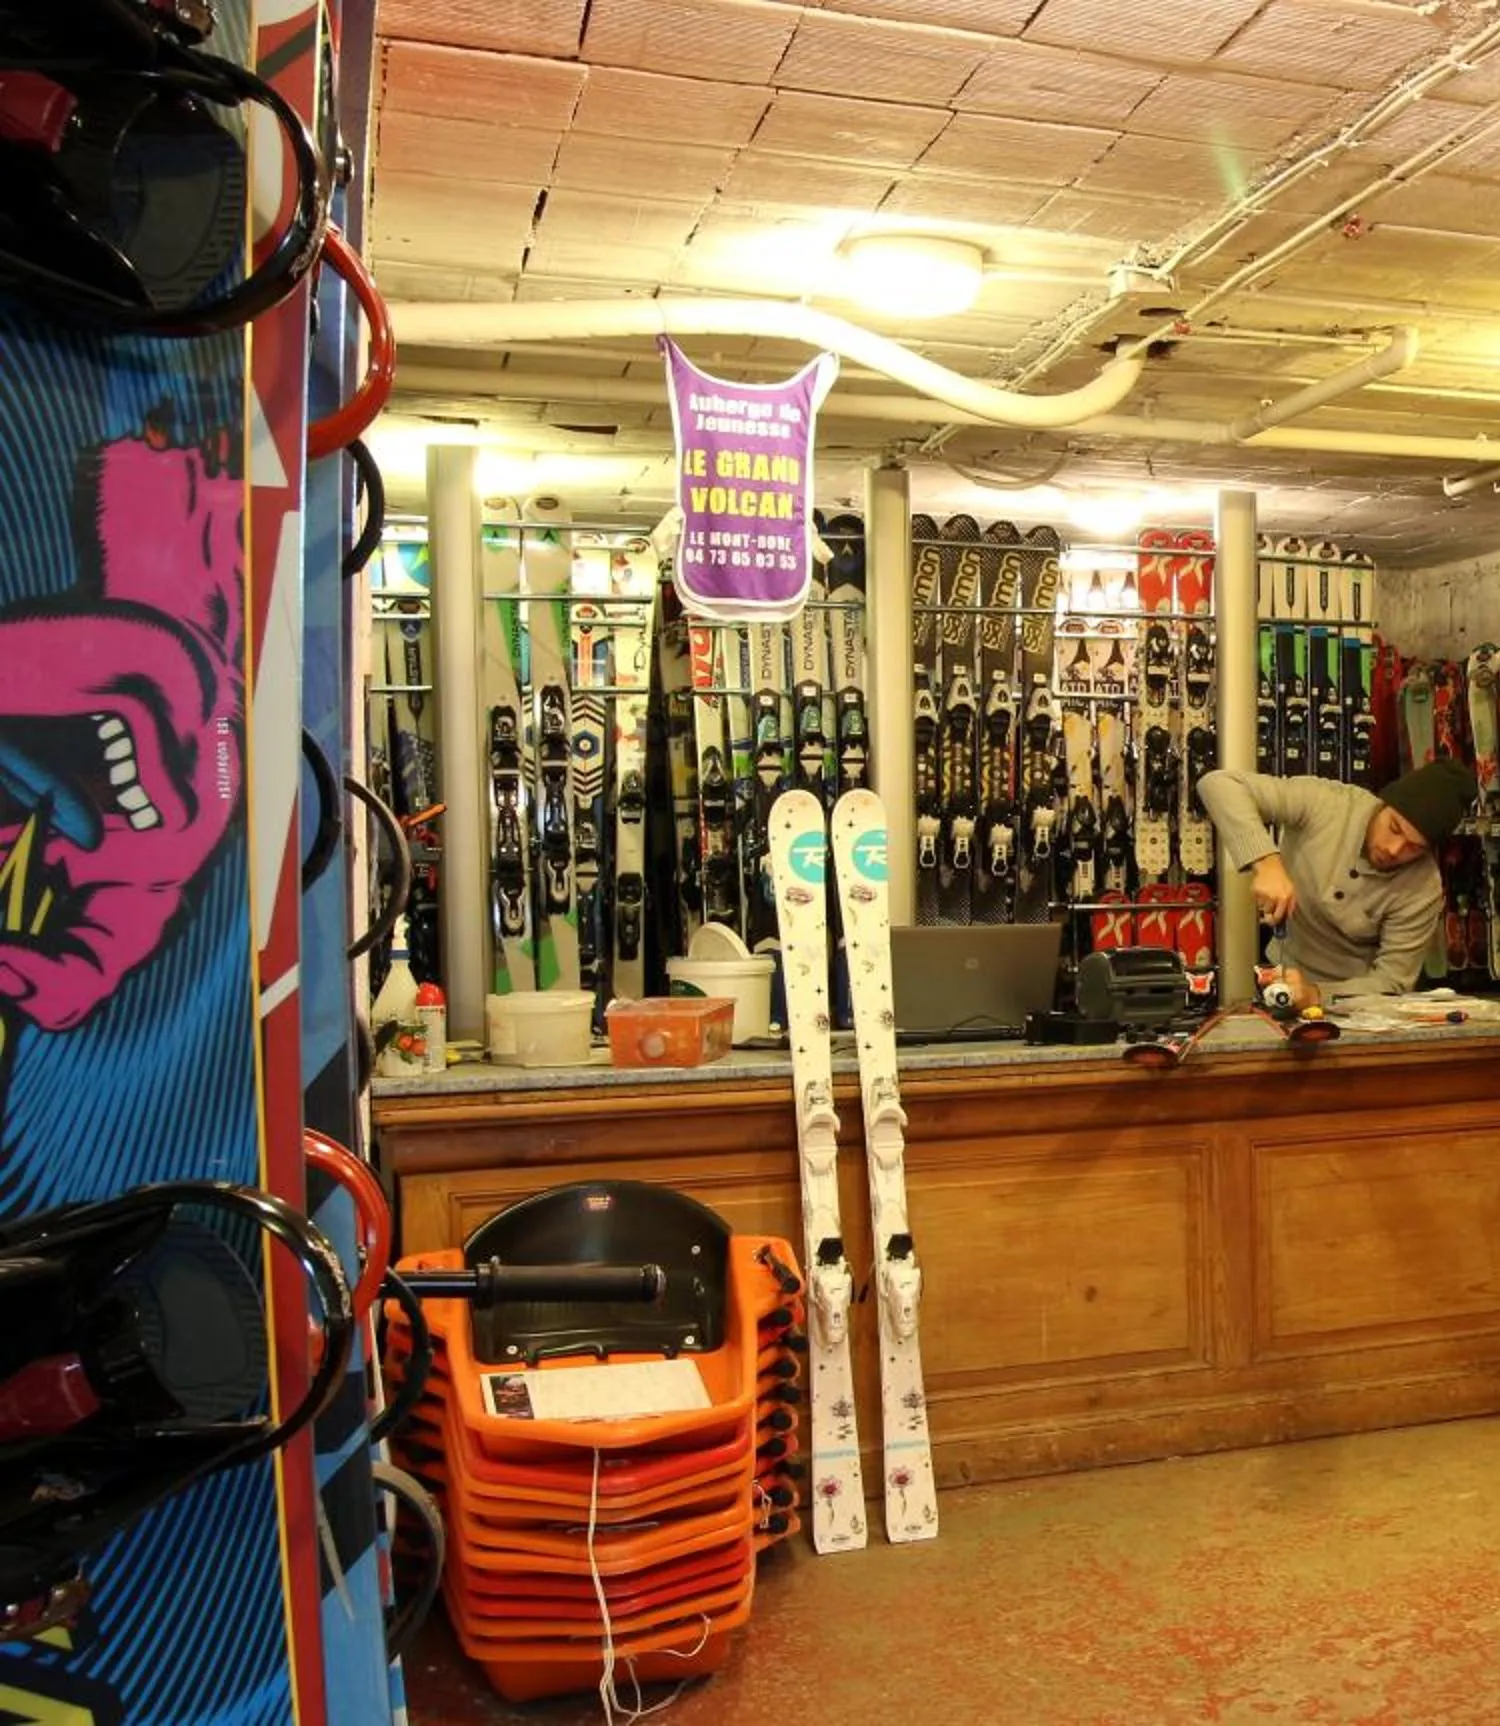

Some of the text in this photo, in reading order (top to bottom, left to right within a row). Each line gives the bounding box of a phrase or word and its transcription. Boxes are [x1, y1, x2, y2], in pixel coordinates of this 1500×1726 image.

[690, 392, 801, 423] Auberge de
[696, 413, 791, 439] Jeunesse
[684, 449, 801, 485] LE GRAND
[690, 487, 794, 520] VOLCAN
[690, 531, 705, 547] LE
[685, 547, 705, 564] 04
[709, 549, 727, 565] 73
